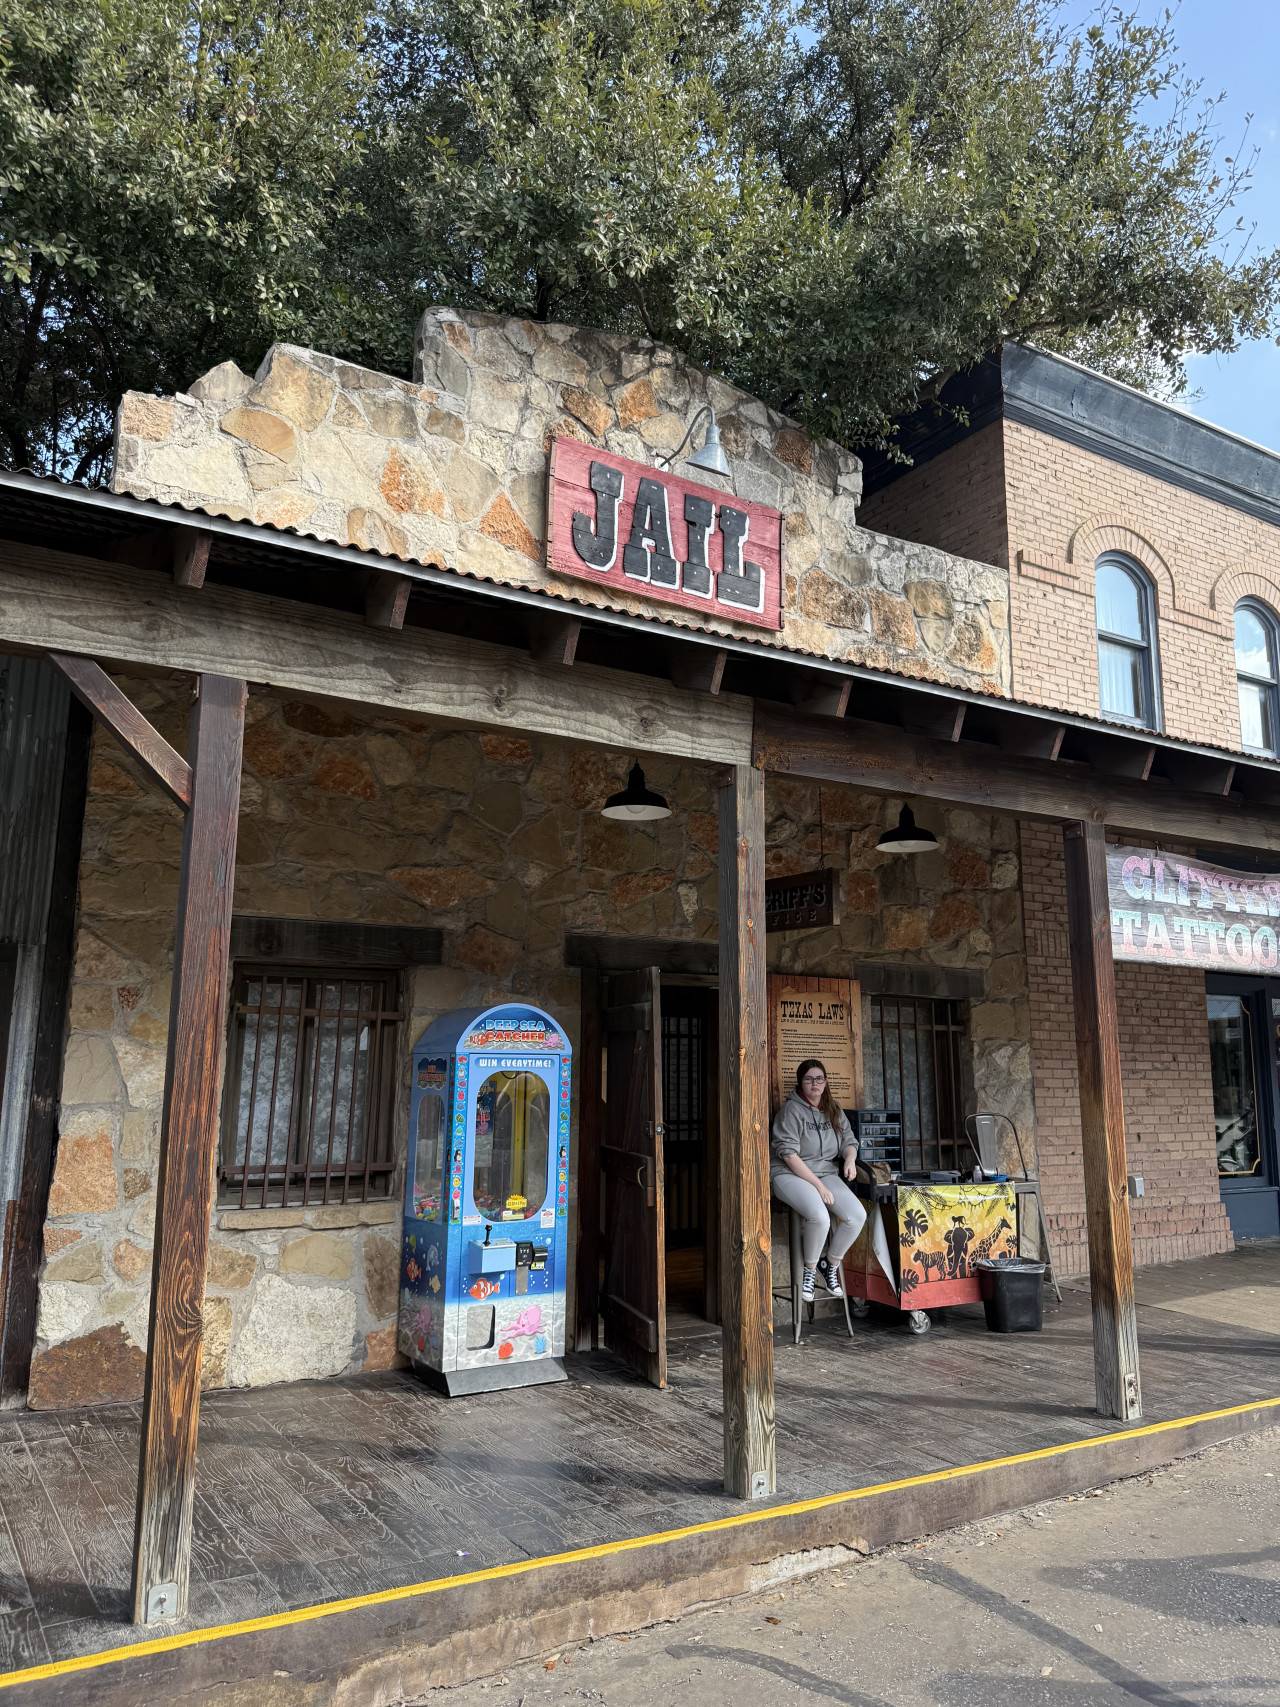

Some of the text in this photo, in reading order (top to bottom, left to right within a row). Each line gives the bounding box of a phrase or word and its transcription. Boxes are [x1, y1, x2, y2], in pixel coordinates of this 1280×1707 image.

[571, 460, 766, 614] JAIL
[765, 884, 824, 912] ERIFF'S
[1122, 856, 1280, 917] GLITTER
[1112, 909, 1278, 968] TATTOO
[781, 1001, 844, 1020] TEXAS LAWS
[485, 1019, 546, 1031] DEEP SEA
[486, 1031, 545, 1042] CATCHER
[479, 1058, 552, 1068] WIN EVERYTIME!
